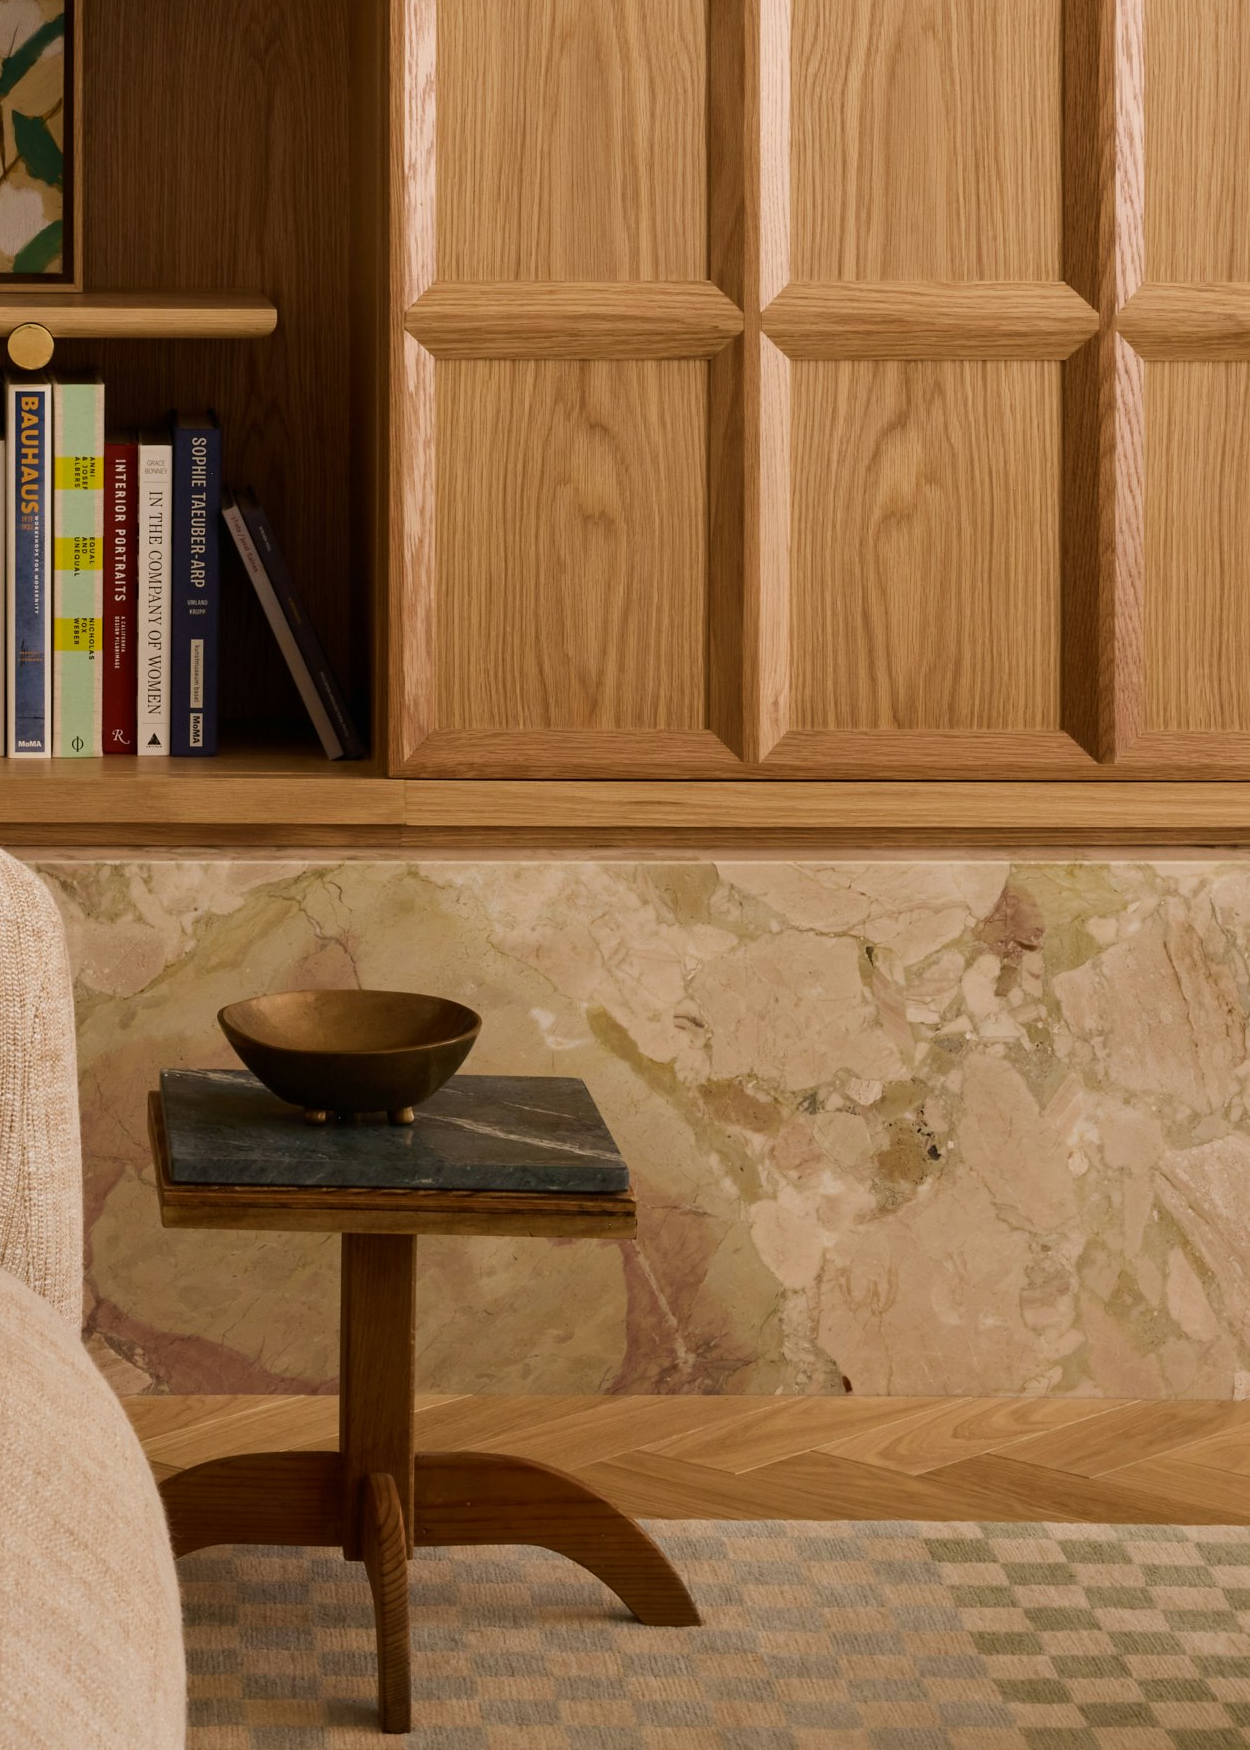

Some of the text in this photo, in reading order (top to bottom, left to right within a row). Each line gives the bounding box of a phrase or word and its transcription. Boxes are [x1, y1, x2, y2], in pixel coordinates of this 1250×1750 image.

[21, 396, 39, 515] BAUHAUS
[191, 437, 207, 588] SOPHIE TAEUBER-ARP
[115, 459, 127, 602] INTERIOR PORTRAITS
[148, 490, 163, 715] IN THE COMPANY OF WOMEN
[192, 715, 201, 744] MoMA
